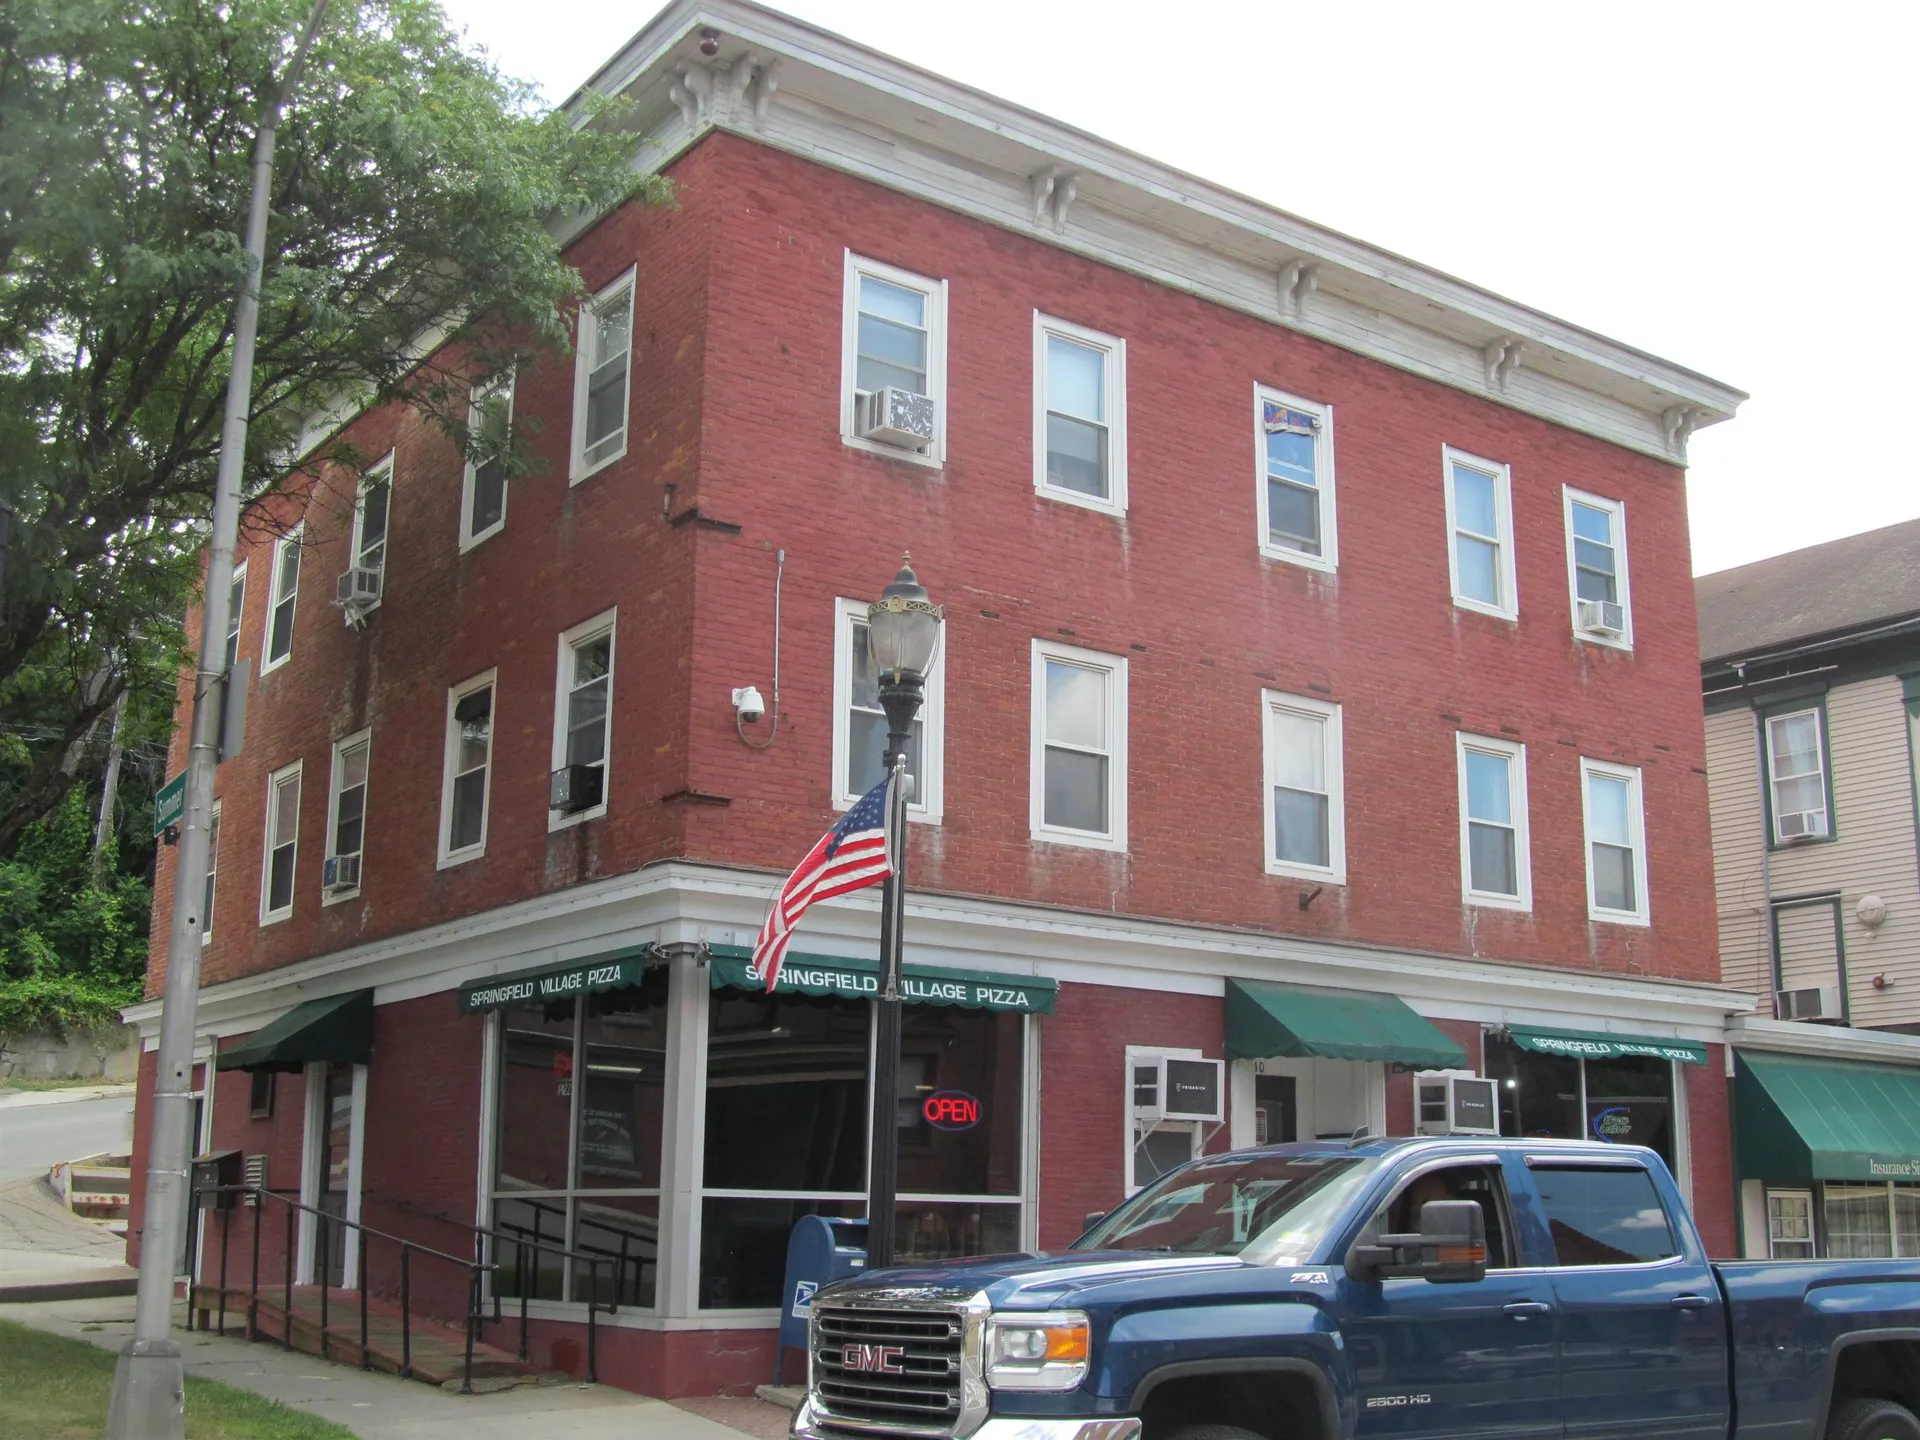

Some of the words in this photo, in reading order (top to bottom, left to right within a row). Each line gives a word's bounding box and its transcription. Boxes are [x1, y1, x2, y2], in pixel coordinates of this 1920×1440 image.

[158, 787, 183, 824] Summer
[470, 982, 533, 1006] SPRINGFIELD
[540, 972, 583, 995] VILLAGE
[587, 965, 621, 986] PIZZA
[901, 979, 967, 1000] ILLAGE
[976, 987, 1029, 1006] PIZZA
[1532, 1038, 1611, 1054] SPRINGFIELD
[1614, 1043, 1662, 1055] VILLAGE
[1663, 1048, 1697, 1061] PIZZA
[924, 1098, 977, 1122] OPEN
[1870, 1158, 1911, 1175] Insurance
[842, 1343, 904, 1374] GMC
[1366, 1396, 1407, 1408] 2500
[1409, 1394, 1431, 1404] HD
